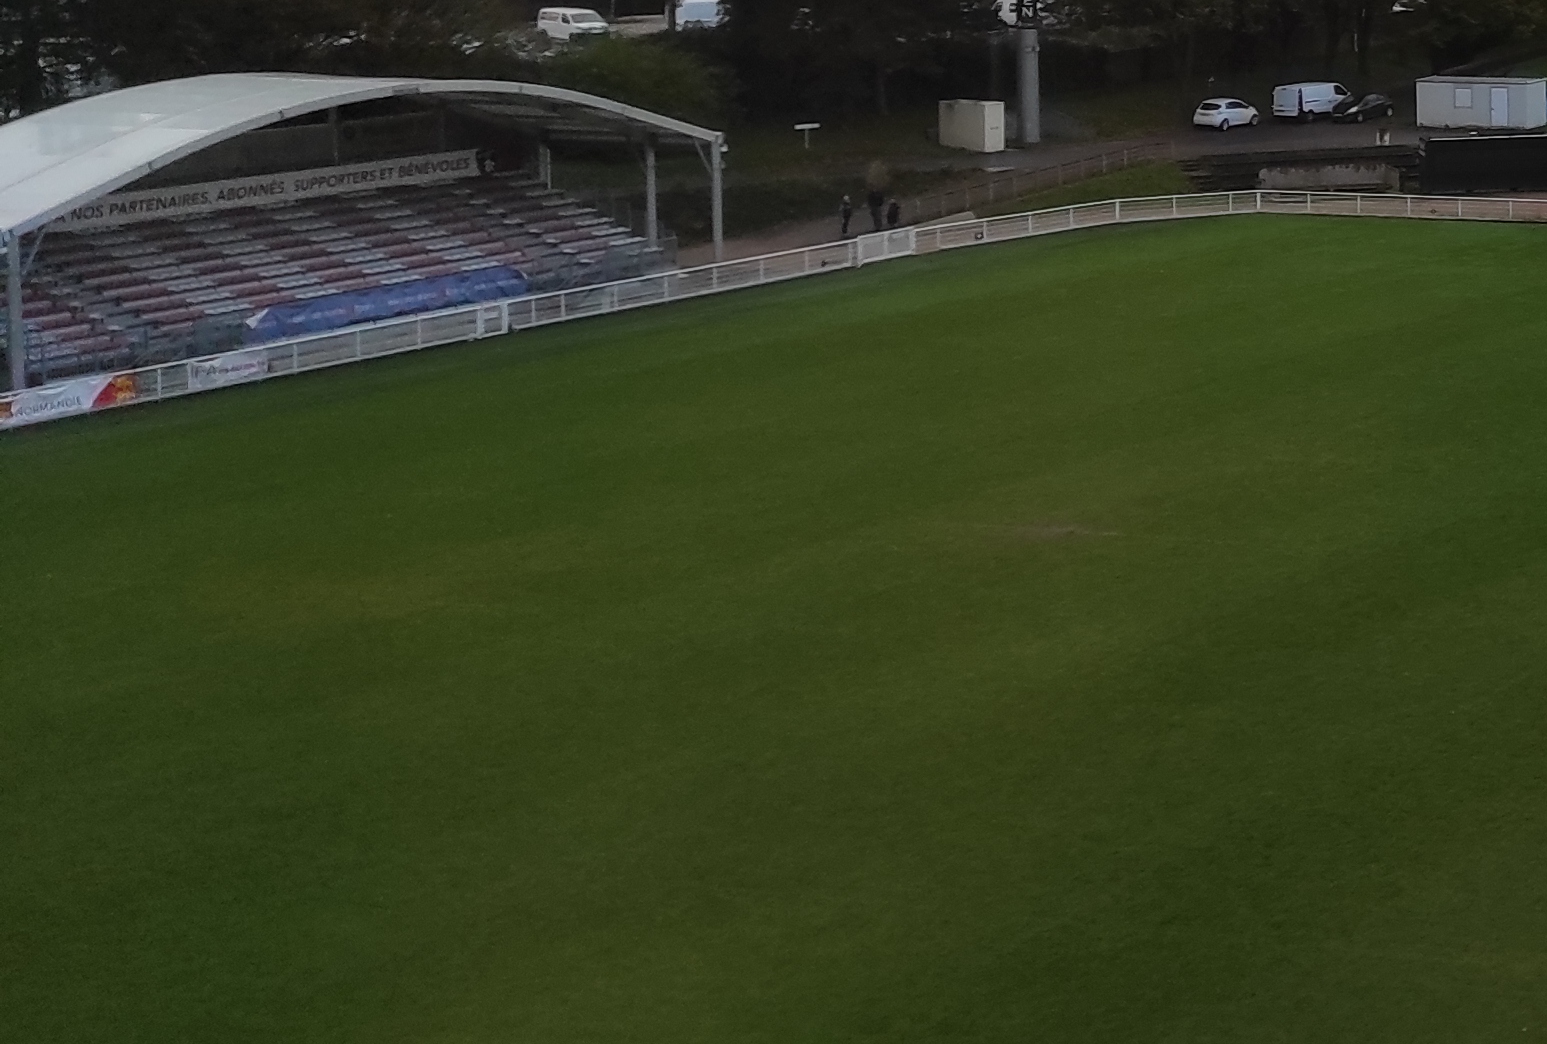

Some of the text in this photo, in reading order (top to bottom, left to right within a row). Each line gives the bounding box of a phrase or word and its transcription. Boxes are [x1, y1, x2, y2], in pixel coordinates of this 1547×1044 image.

[71, 205, 104, 220] NOS
[293, 170, 377, 192] SUPPORTERS
[379, 166, 395, 179] ET
